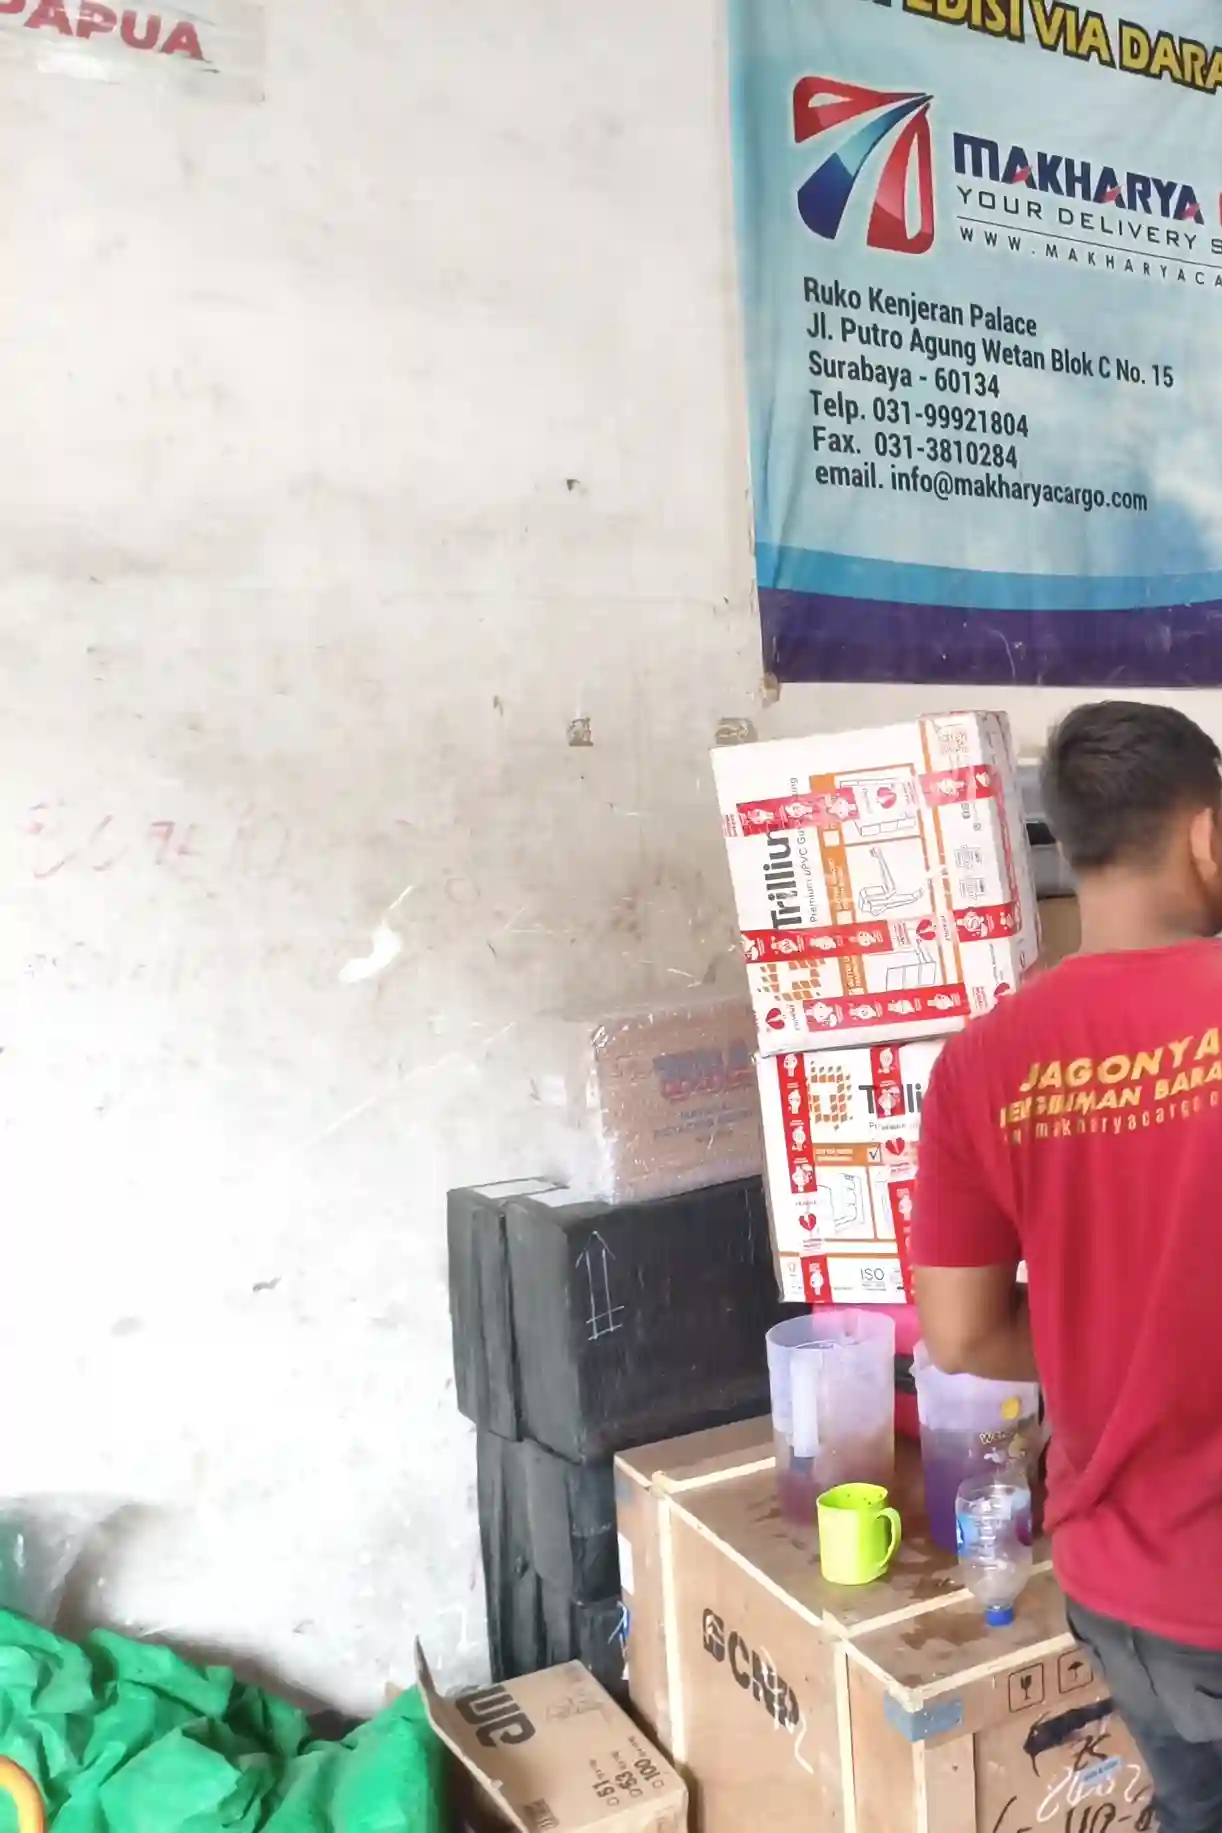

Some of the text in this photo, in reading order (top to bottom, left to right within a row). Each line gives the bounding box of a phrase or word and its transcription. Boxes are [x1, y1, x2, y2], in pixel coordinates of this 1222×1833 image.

[1029, 0, 1117, 69] VIA
[952, 131, 1205, 225] MAKHARYA
[957, 186, 1043, 221] YOUR
[1058, 207, 1197, 249] DELIVERY
[803, 276, 1037, 337] Ruko Kenjeran Palace
[806, 312, 1174, 388] Jl. Putro Agung Wetan Blok C No. 15
[809, 351, 912, 391] Surabaya
[934, 368, 1000, 399] 60134
[809, 390, 1029, 438] Telp. 031-99921804
[812, 426, 1018, 469] Fax. 031-3810284
[815, 462, 1148, 512] email. info@makharyacargo.com
[1020, 1027, 1220, 1092] JAGONYA
[861, 1267, 885, 1281] ISO
